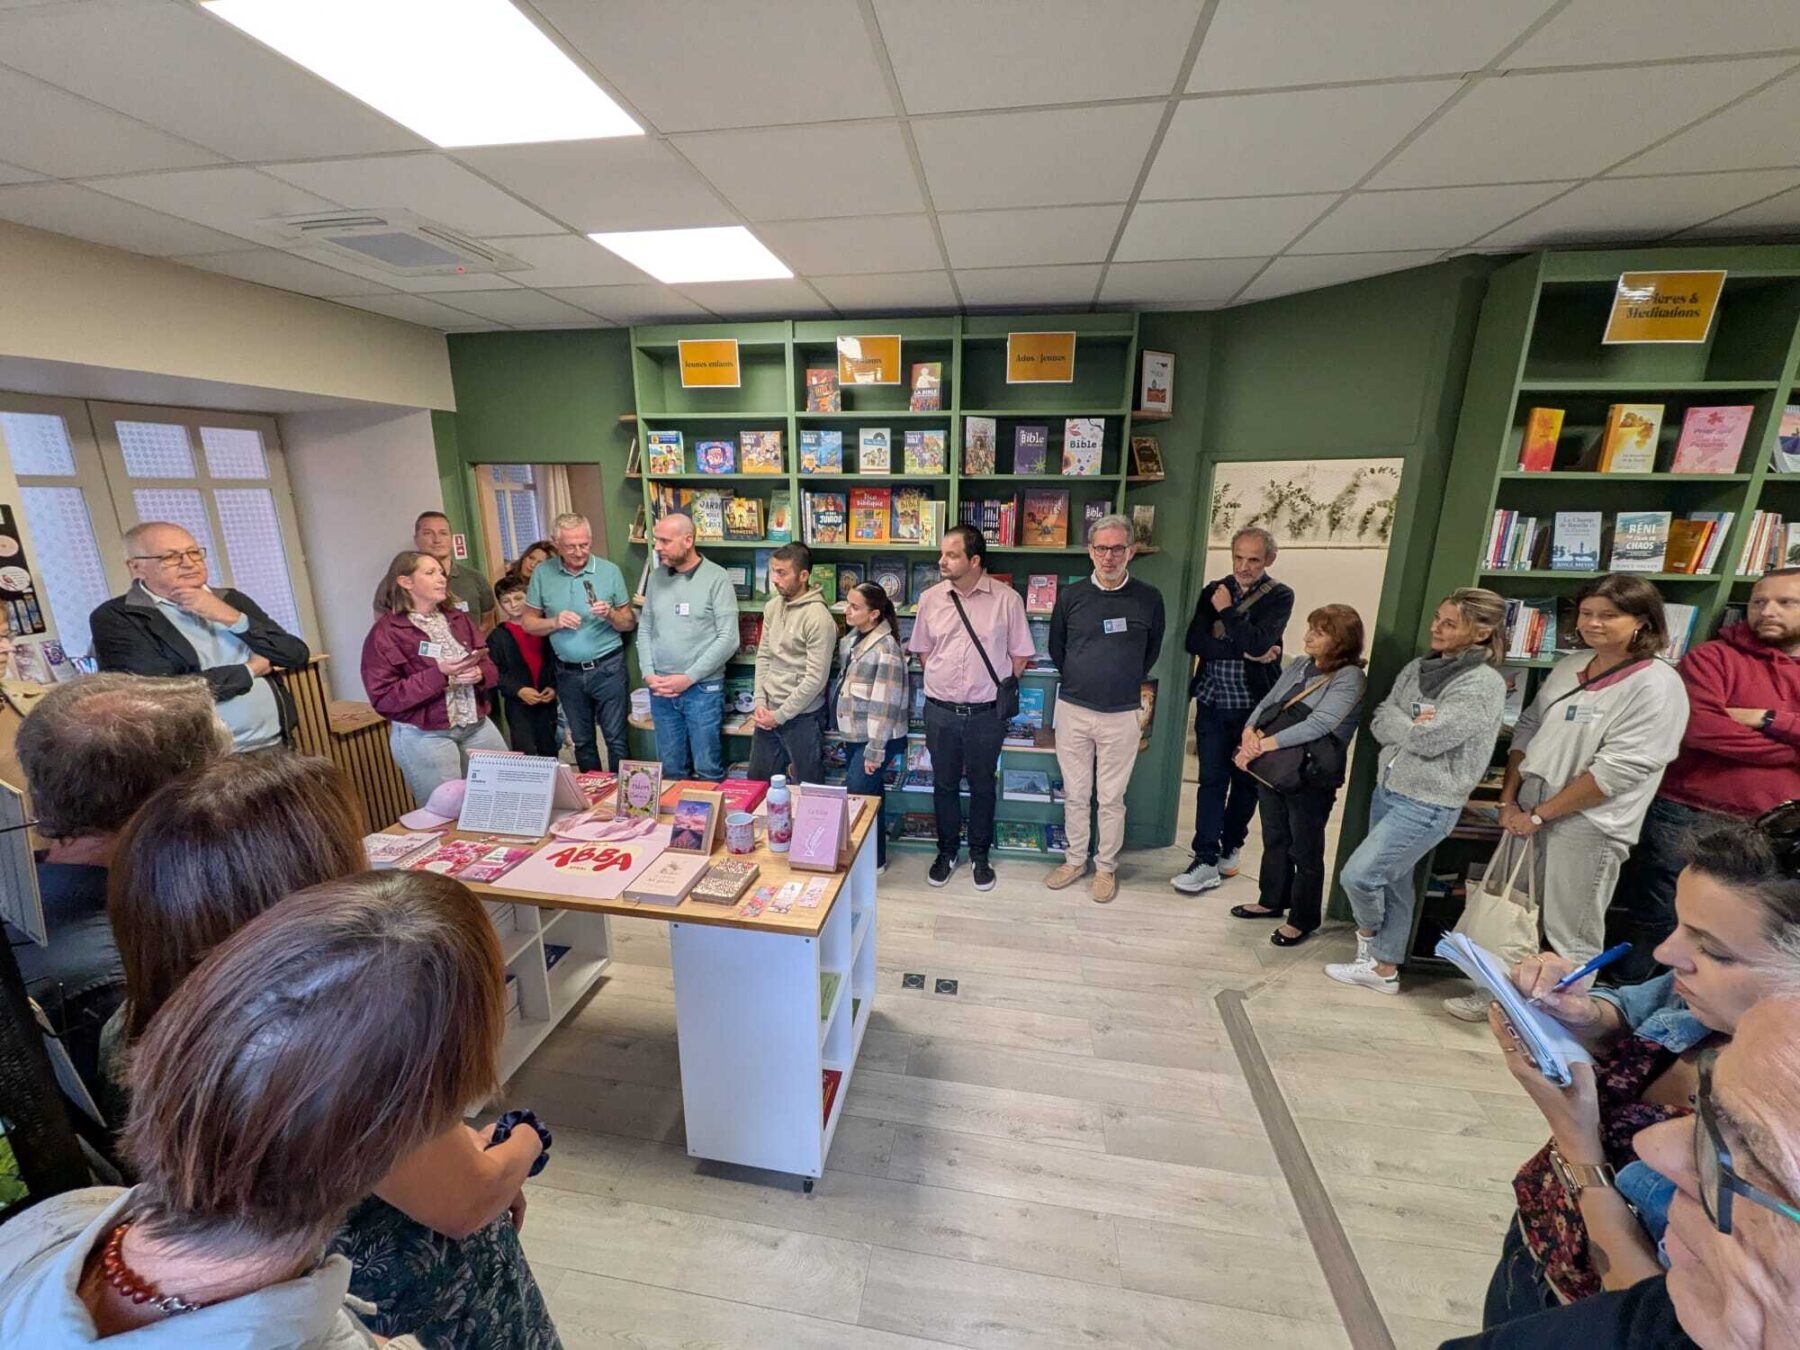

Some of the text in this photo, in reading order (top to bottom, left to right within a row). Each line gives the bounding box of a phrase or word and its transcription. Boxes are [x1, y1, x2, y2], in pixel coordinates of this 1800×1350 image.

[1689, 292, 1699, 304] &
[1021, 431, 1045, 444] Bible
[1069, 440, 1097, 449] Bible
[1626, 541, 1654, 550] CHAOS
[545, 846, 633, 872] ABBA
